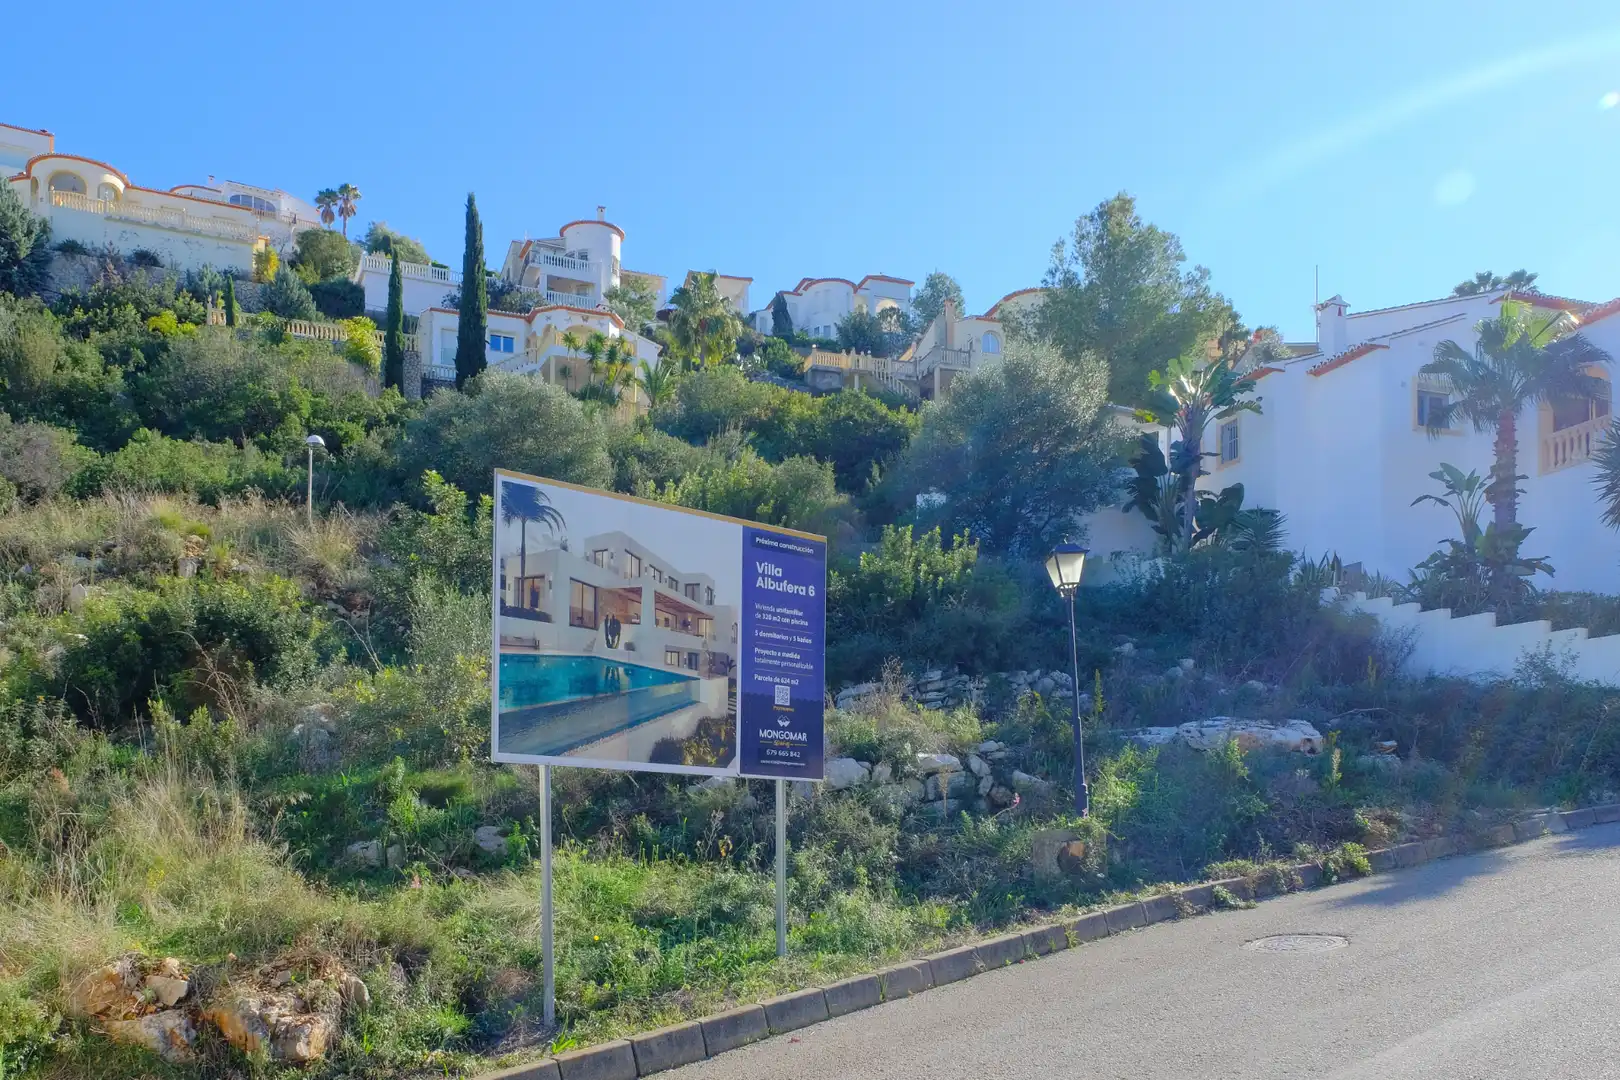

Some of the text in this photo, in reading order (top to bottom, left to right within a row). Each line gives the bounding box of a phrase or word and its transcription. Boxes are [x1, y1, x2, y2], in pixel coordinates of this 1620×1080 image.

[756, 562, 782, 577] Villa
[756, 576, 816, 597] Albufera 6
[755, 647, 777, 656] Proyecto
[754, 674, 772, 682] Parcela
[760, 728, 808, 742] MONGOMAR
